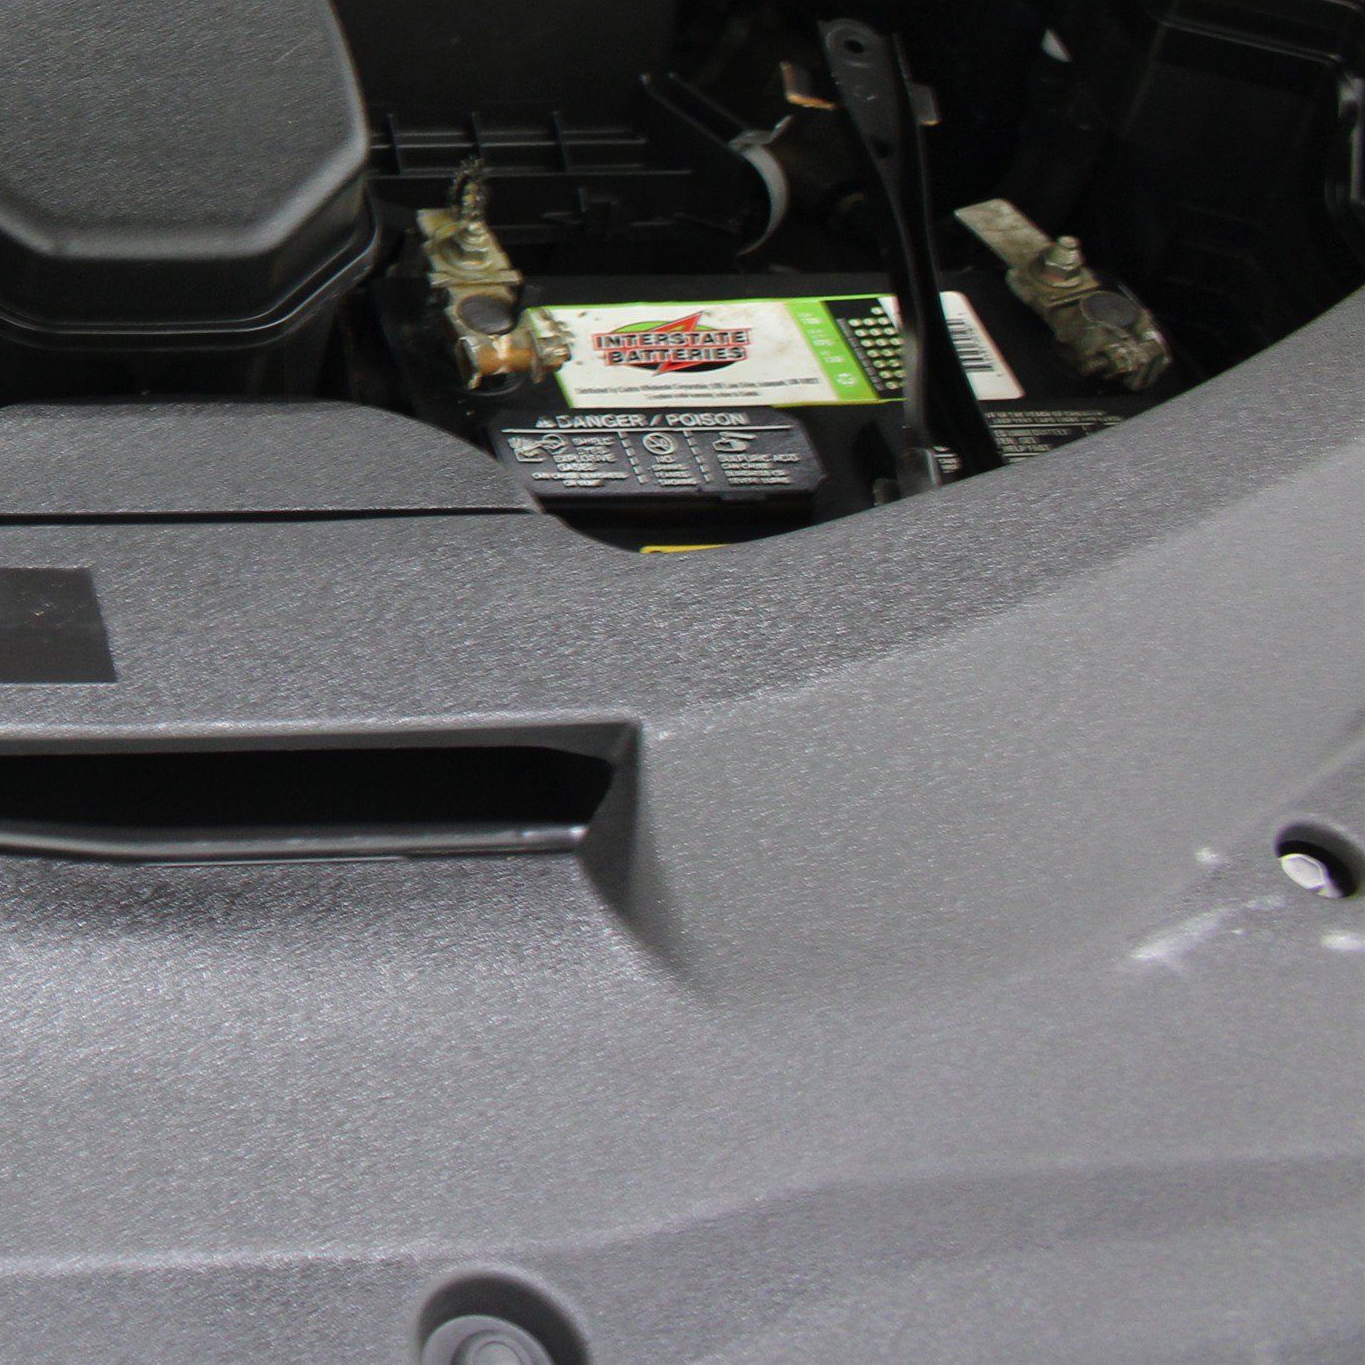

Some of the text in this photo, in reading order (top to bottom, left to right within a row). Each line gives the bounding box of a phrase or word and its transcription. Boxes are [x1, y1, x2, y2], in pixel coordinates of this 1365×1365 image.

[595, 329, 750, 348] INTERSTATE
[609, 347, 746, 364] BATTERIES
[556, 413, 649, 428] DANGER
[666, 412, 748, 426] POISON
